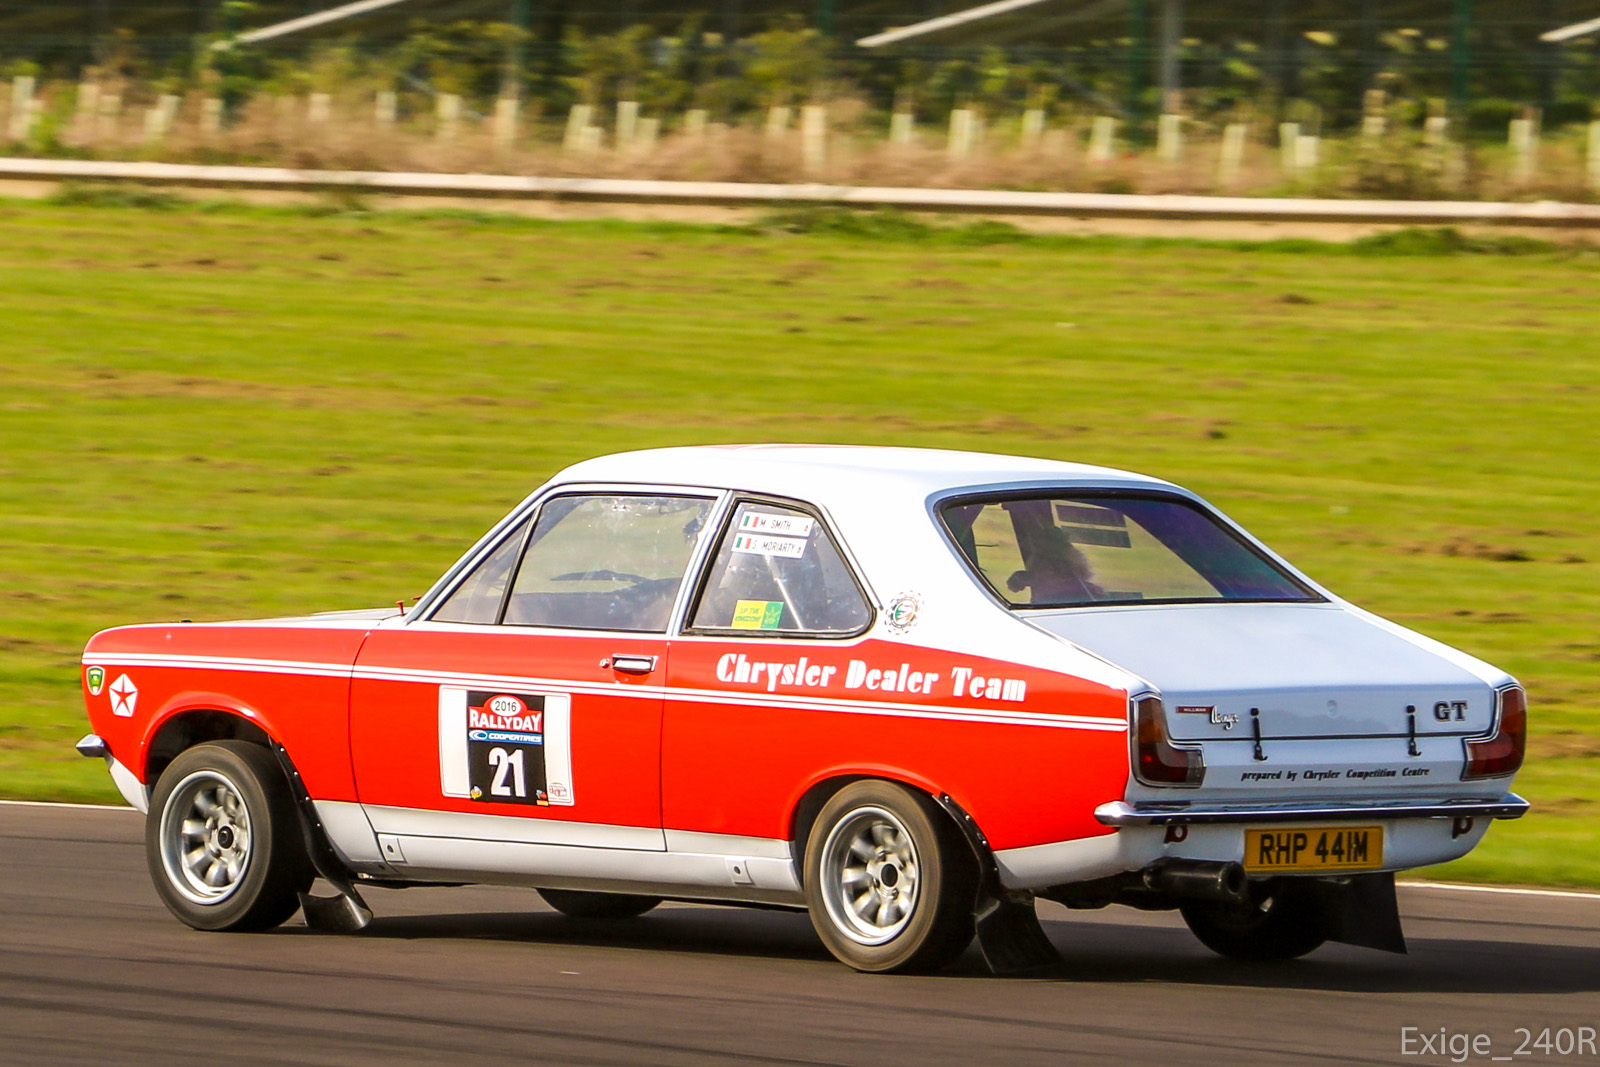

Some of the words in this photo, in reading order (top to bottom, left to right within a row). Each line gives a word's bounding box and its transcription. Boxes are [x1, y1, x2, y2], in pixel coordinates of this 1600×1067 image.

[771, 520, 792, 529] SMITH
[762, 542, 796, 553] MORIARTY
[716, 653, 836, 691] Chrysler
[845, 660, 939, 693] Dealer
[951, 666, 1026, 701] Team
[495, 701, 517, 712] 2016
[1434, 701, 1468, 721] GT
[469, 709, 541, 731] RALLYDAY
[488, 747, 526, 798] 21
[1241, 771, 1282, 781] prepared
[1286, 771, 1298, 781] by
[1303, 769, 1341, 781] Chrysler
[1346, 768, 1397, 779] Competition
[1401, 767, 1430, 777] Centre
[1259, 832, 1307, 864] RHP
